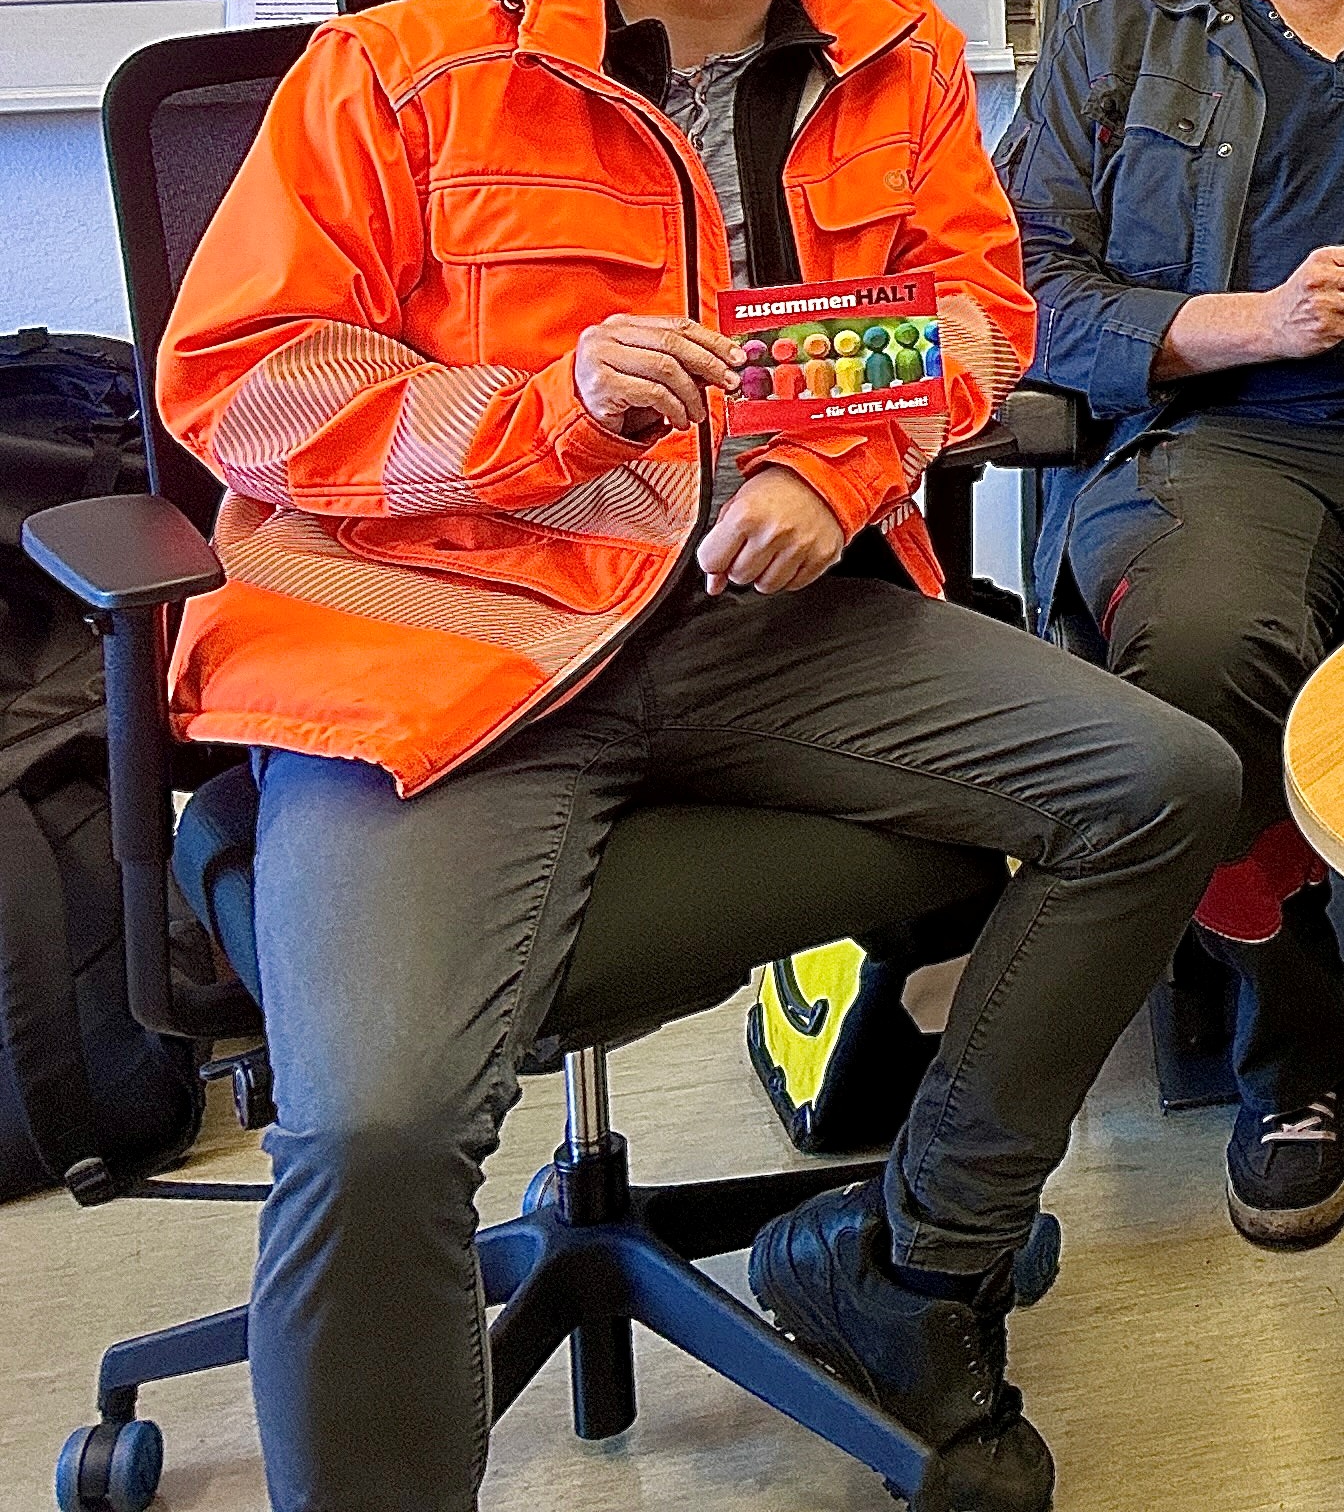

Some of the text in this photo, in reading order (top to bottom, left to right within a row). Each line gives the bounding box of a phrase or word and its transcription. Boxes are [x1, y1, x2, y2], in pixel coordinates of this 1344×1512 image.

[735, 283, 917, 319] zusammenHALT
[825, 405, 846, 418] für
[847, 400, 883, 416] GUTE
[884, 395, 929, 411] Arbeit!
